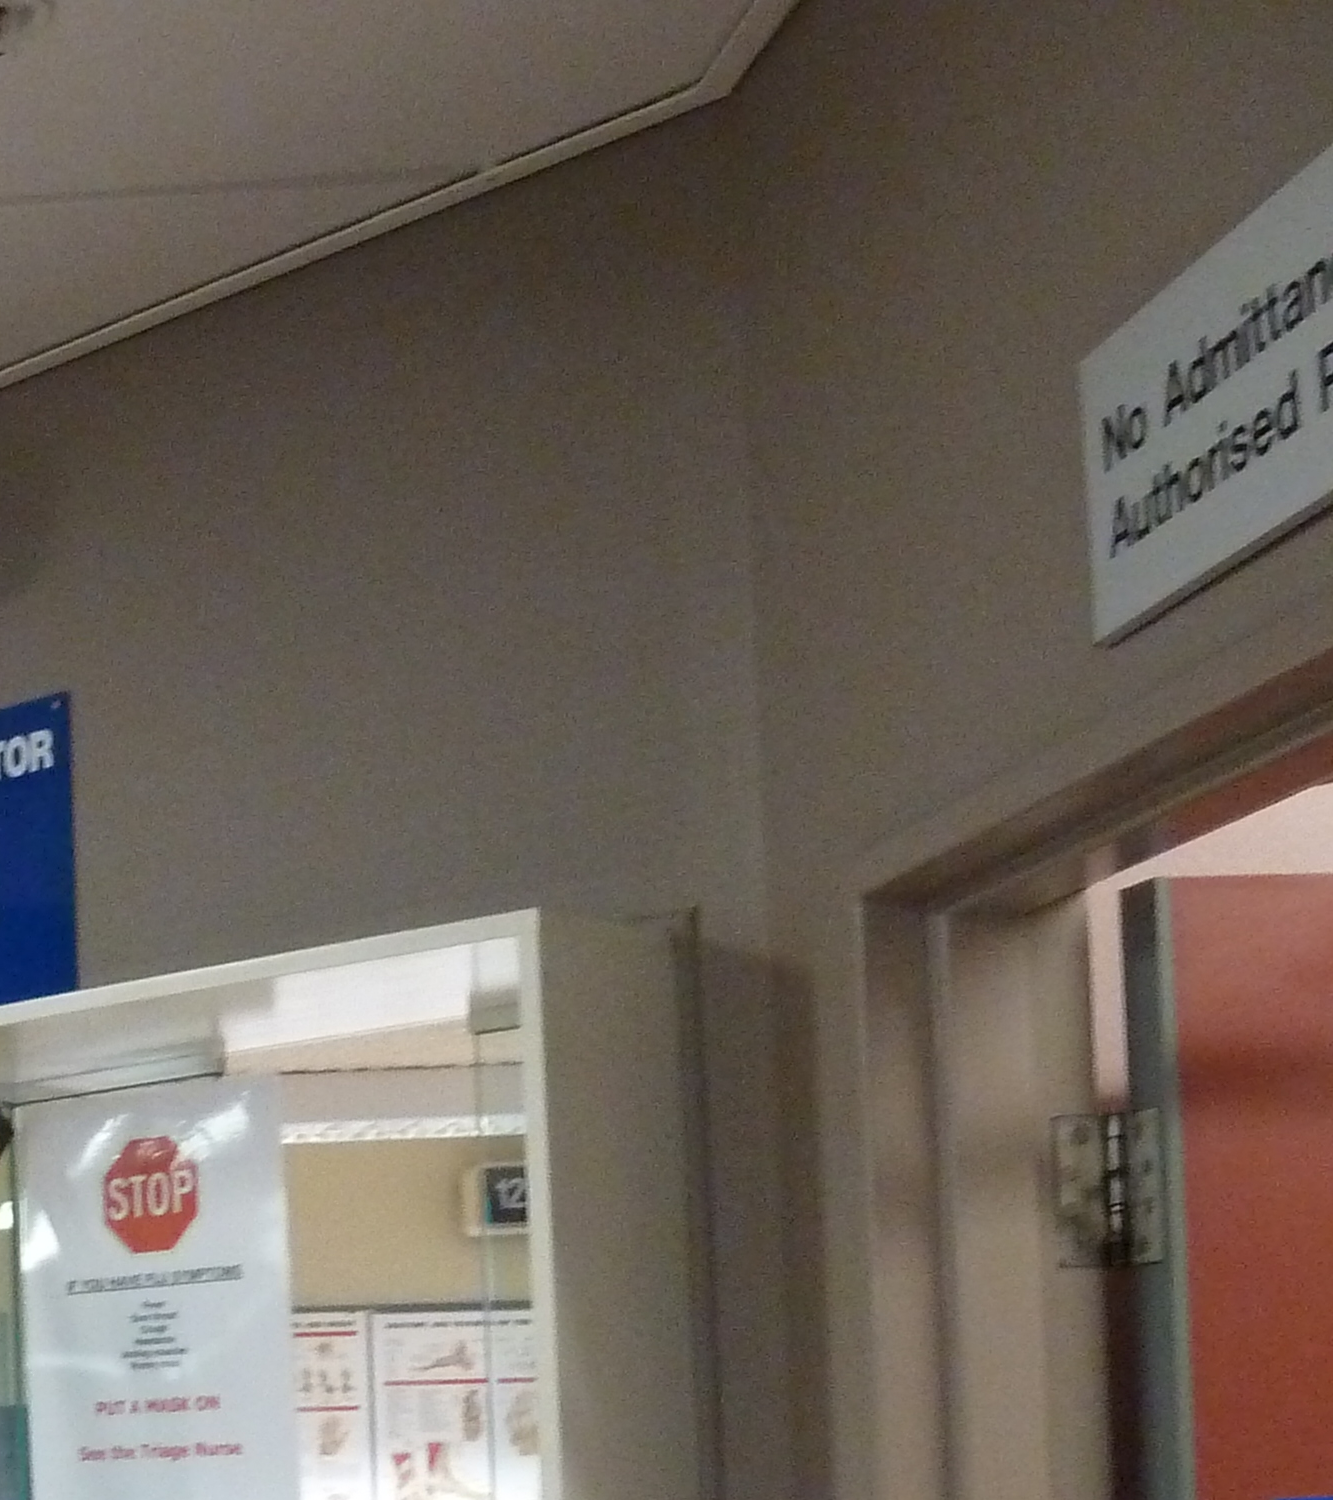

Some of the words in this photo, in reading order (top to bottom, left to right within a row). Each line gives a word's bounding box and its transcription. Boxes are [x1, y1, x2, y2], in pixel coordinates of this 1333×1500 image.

[1101, 404, 1147, 472] No
[1109, 369, 1303, 558] Authorised
[108, 1170, 195, 1220] STOP
[95, 1399, 126, 1415] PUT
[130, 1399, 140, 1414] A
[145, 1397, 189, 1413] MASK
[196, 1395, 220, 1411] ON
[79, 1446, 105, 1461] See
[111, 1445, 135, 1459] the
[140, 1443, 190, 1461] Triage
[195, 1442, 243, 1456] Nurse
